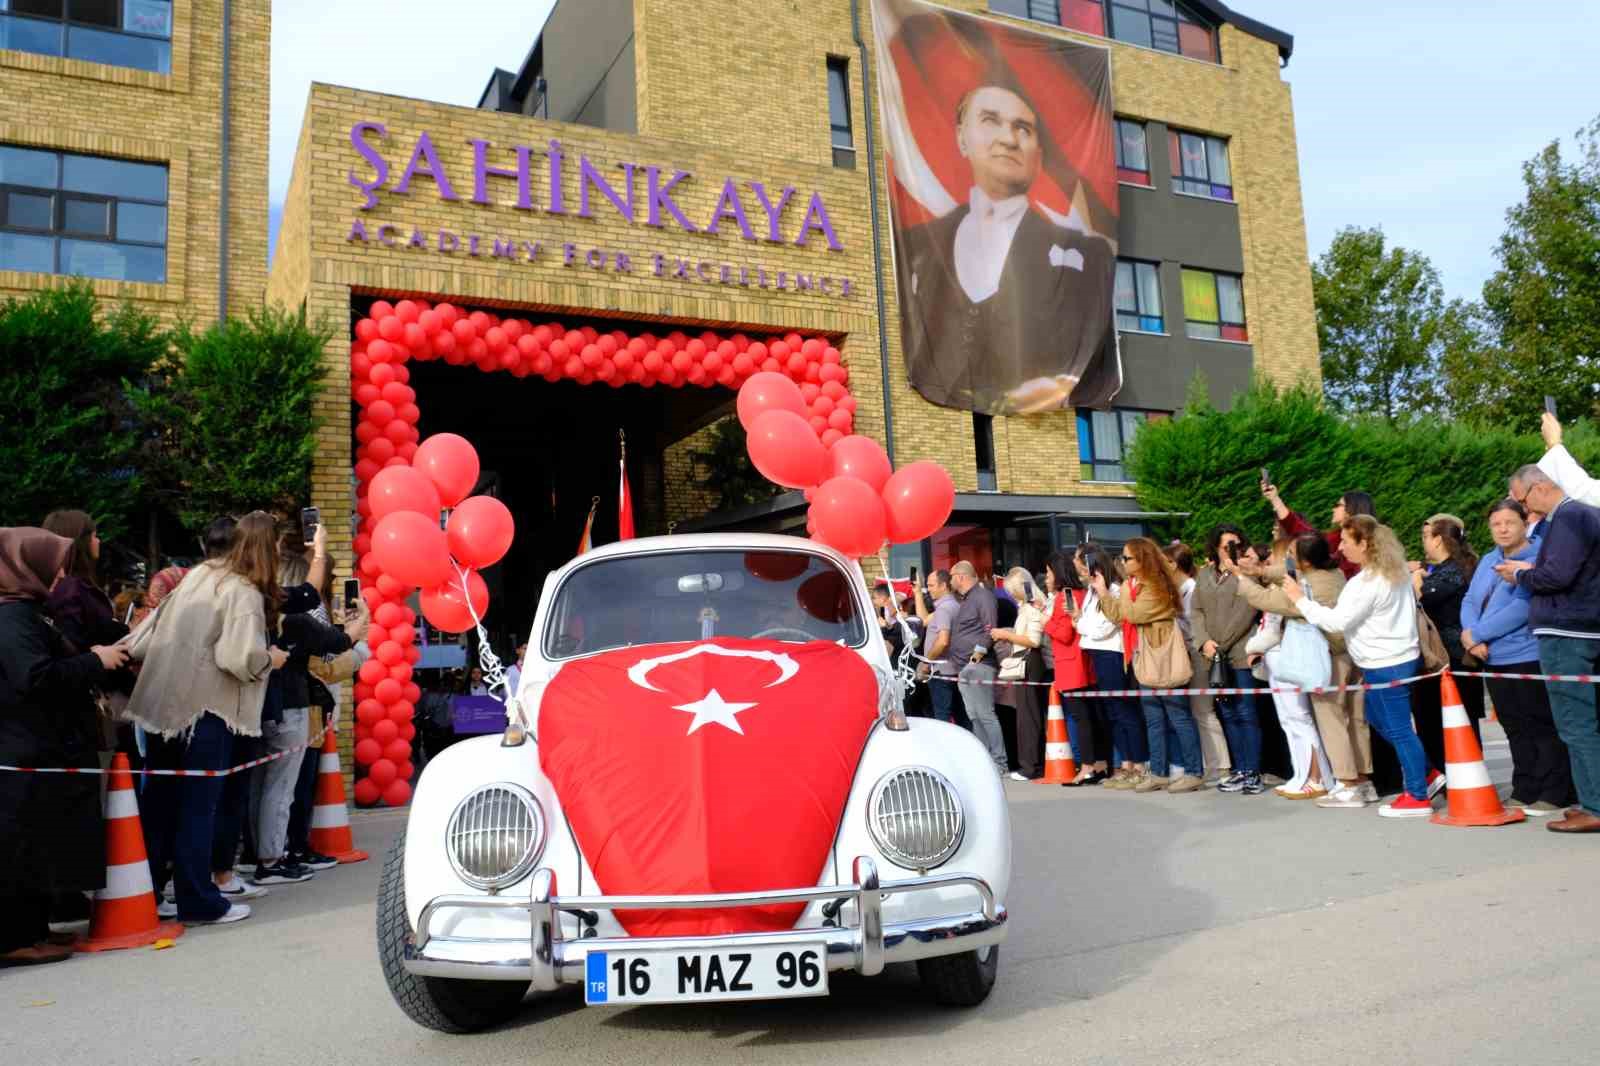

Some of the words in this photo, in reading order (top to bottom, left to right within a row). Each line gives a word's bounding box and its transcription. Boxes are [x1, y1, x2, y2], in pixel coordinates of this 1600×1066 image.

[349, 121, 844, 251] ŞAHİNKAYA
[347, 219, 542, 263] ACADEMY
[563, 242, 632, 273] FOR
[653, 253, 854, 298] EXCELLENCE
[590, 982, 606, 993] TR
[612, 958, 650, 996] 16
[677, 954, 753, 994] MAZ
[775, 950, 819, 989] 96
